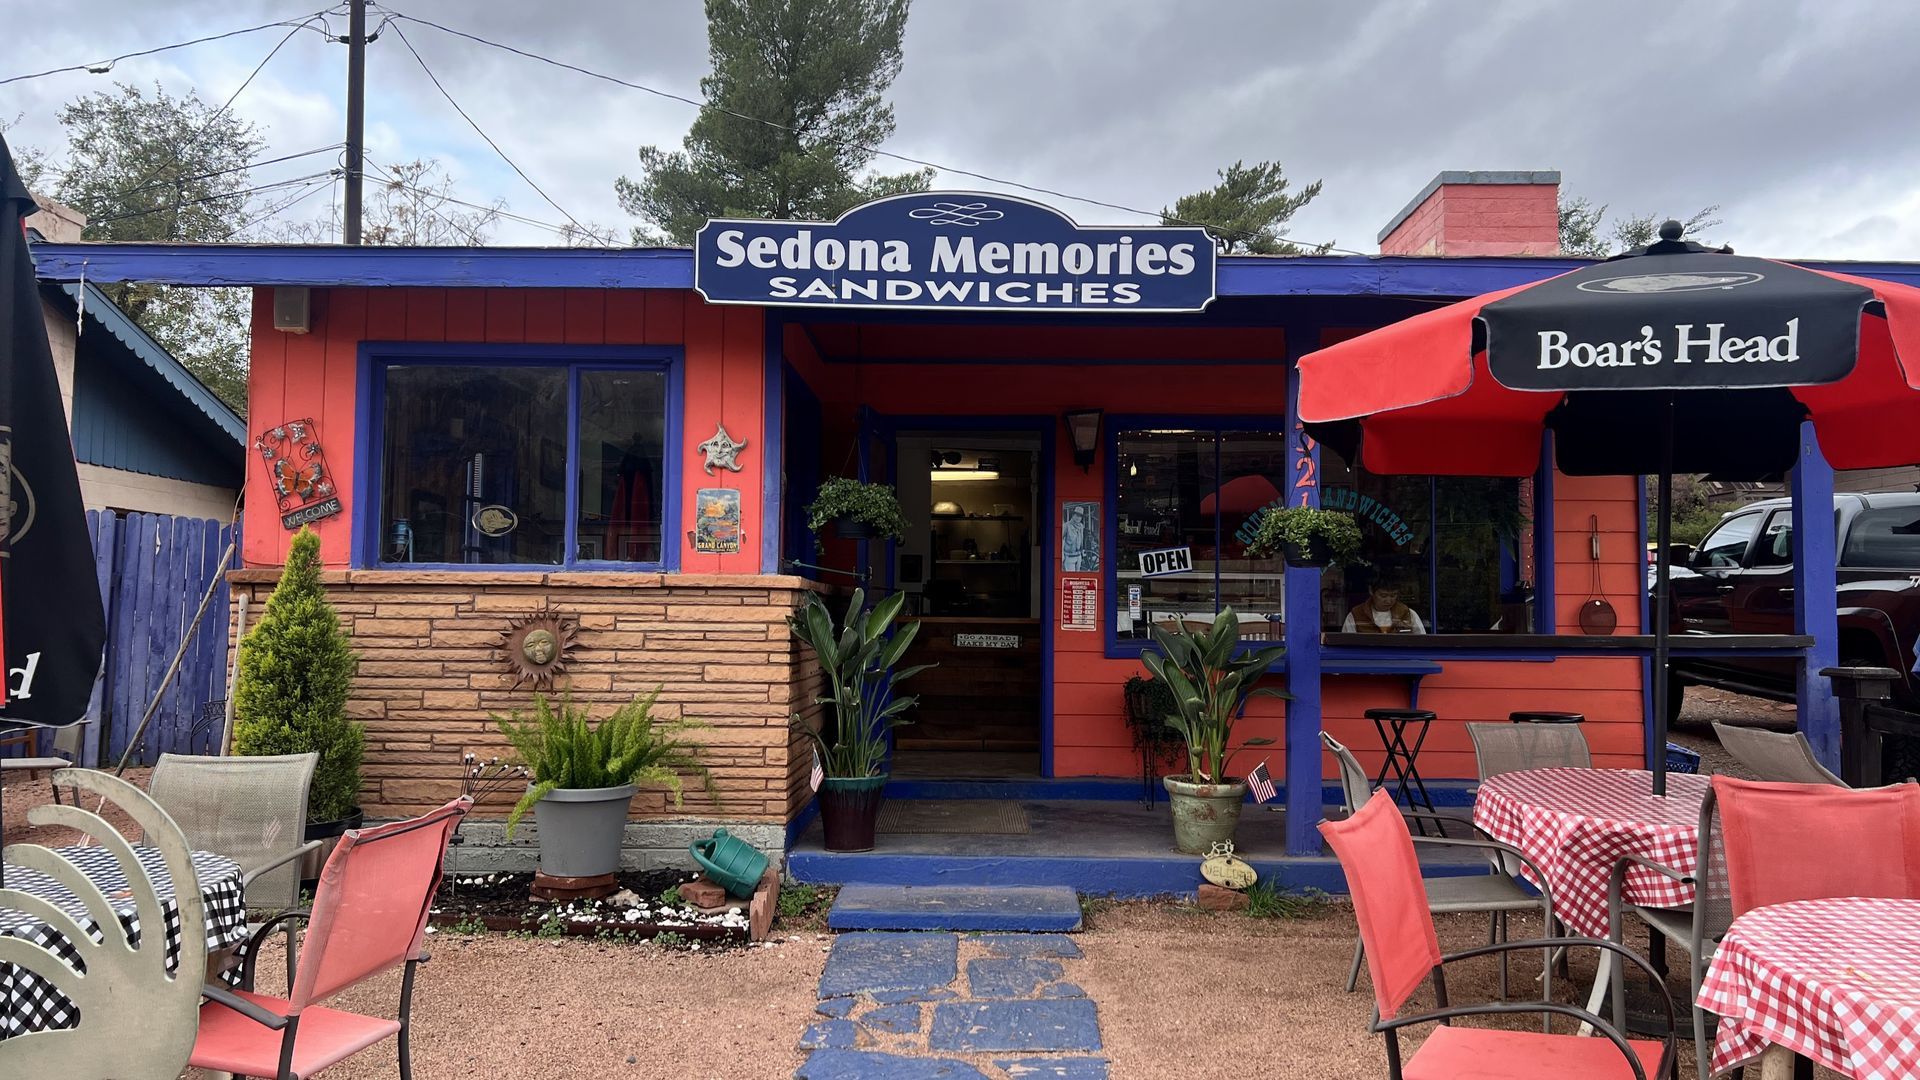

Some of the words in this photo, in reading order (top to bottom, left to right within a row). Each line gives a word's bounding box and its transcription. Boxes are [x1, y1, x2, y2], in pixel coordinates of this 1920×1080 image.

[715, 230, 912, 273] Sedona
[930, 236, 1196, 277] Memories
[768, 276, 1142, 304] SANDWICHES
[1537, 325, 1662, 370] Boar's
[1674, 317, 1800, 364] Head
[286, 500, 338, 526] WELCOME
[1322, 487, 1415, 546] ANDWICHES
[1142, 549, 1189, 574] OPEN
